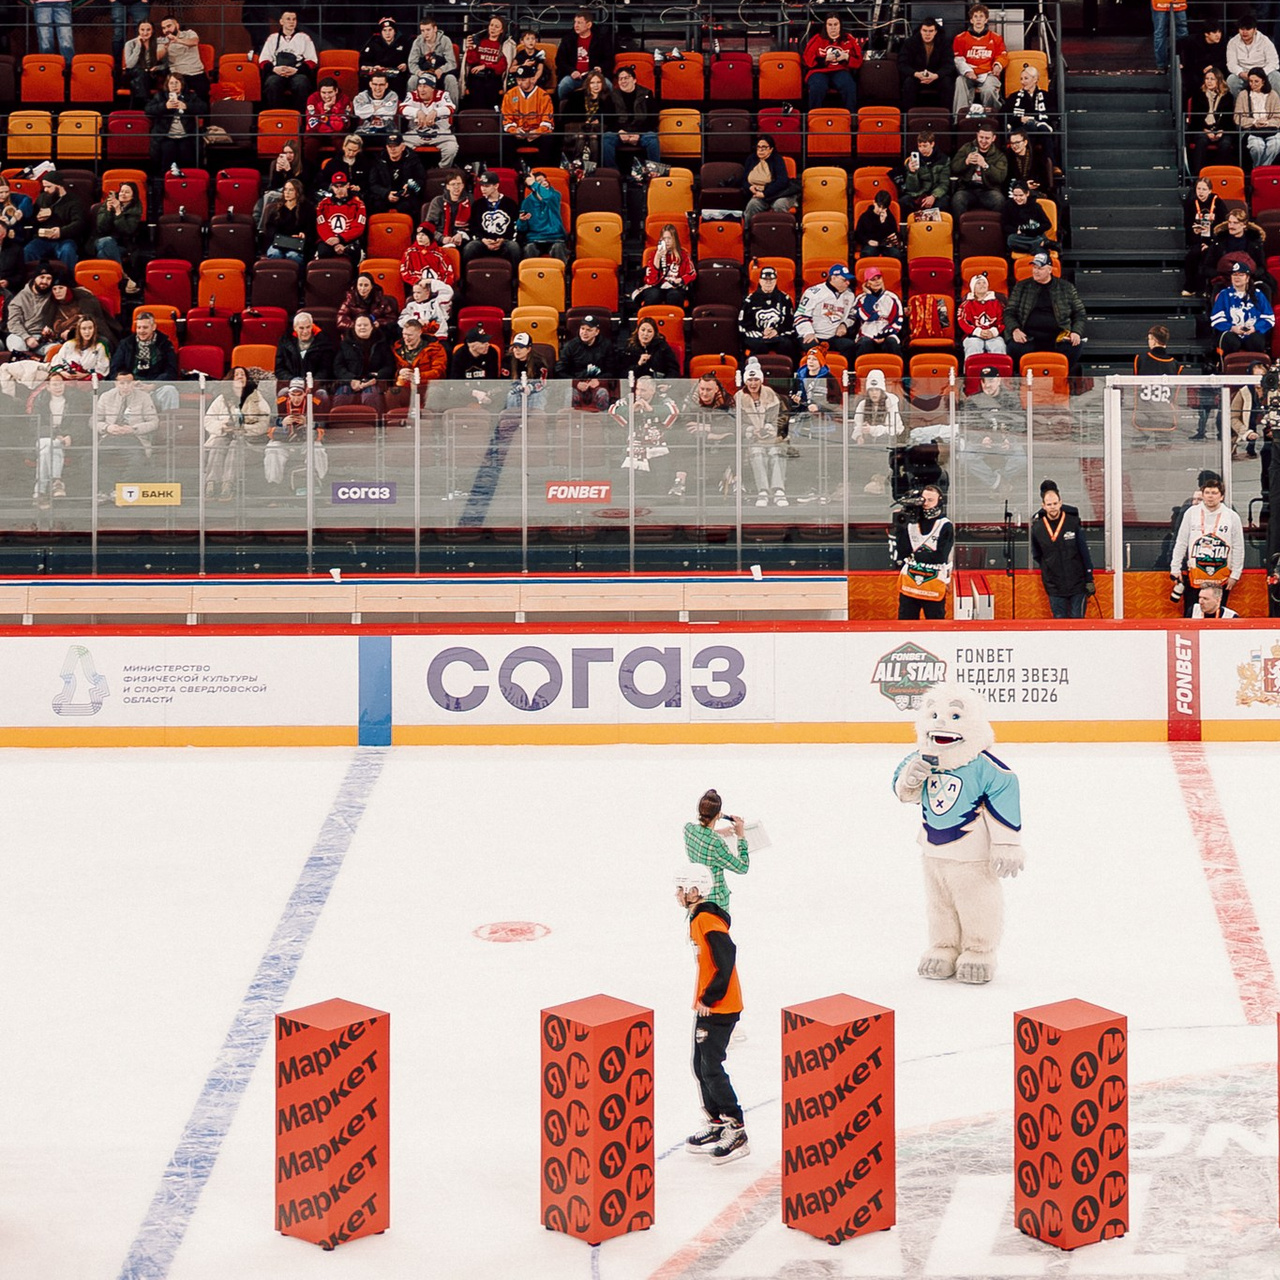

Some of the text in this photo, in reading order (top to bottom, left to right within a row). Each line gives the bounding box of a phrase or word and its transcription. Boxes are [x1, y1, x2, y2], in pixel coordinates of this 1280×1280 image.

[142, 489, 174, 499] БАНК
[547, 486, 610, 499] FONBET
[891, 652, 927, 661] FONBET
[957, 648, 1014, 664] FONBET
[123, 674, 258, 683] ФИЗИЧЕСКОЙ КУЛЬТУРЫ
[871, 661, 947, 683] ALL STAR
[956, 668, 1069, 688] НЕДЕЛЯ ЗВЕЗД
[1174, 634, 1193, 716] FONBET
[179, 684, 267, 695] СВЕРДЛОВСКОЙ
[979, 687, 1058, 703] КЕЯ 2026
[123, 696, 173, 704] ОБЛАСТИ
[279, 1050, 378, 1135] Маркет
[784, 1046, 882, 1129] Маркет
[279, 1097, 378, 1183] Маркет
[785, 1094, 882, 1176] Маркет
[279, 1145, 378, 1228] Маркет
[785, 1141, 883, 1223] Маркет
